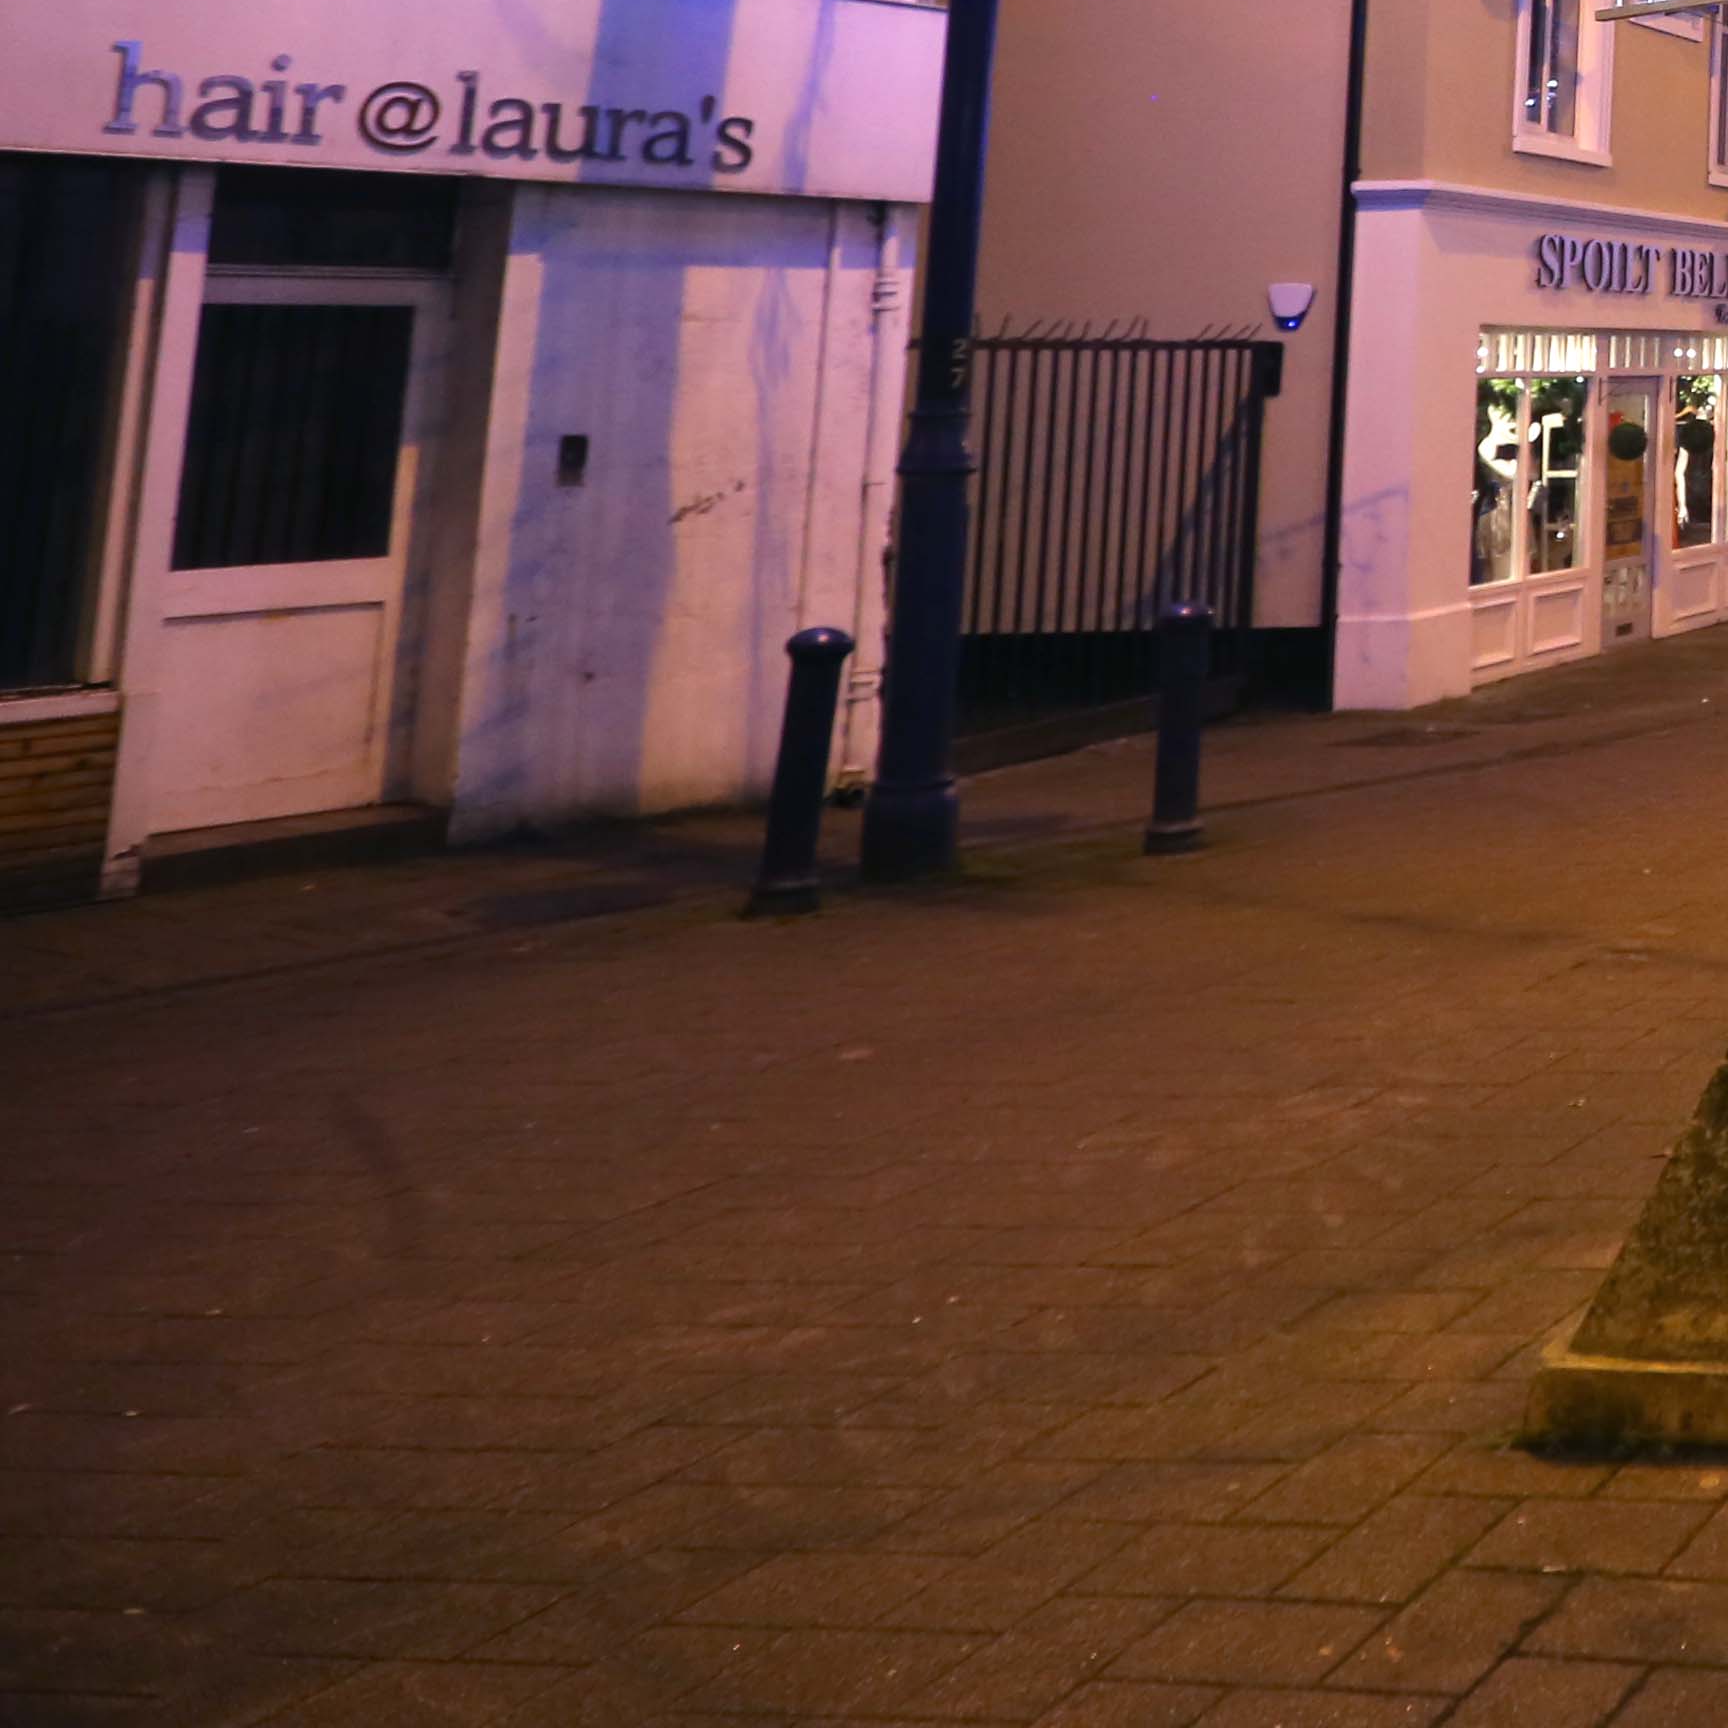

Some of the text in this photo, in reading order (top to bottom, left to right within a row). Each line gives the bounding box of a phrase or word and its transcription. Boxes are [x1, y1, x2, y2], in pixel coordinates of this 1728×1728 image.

[102, 40, 755, 174] hair @ laura's
[1536, 233, 1661, 294] SPOILT
